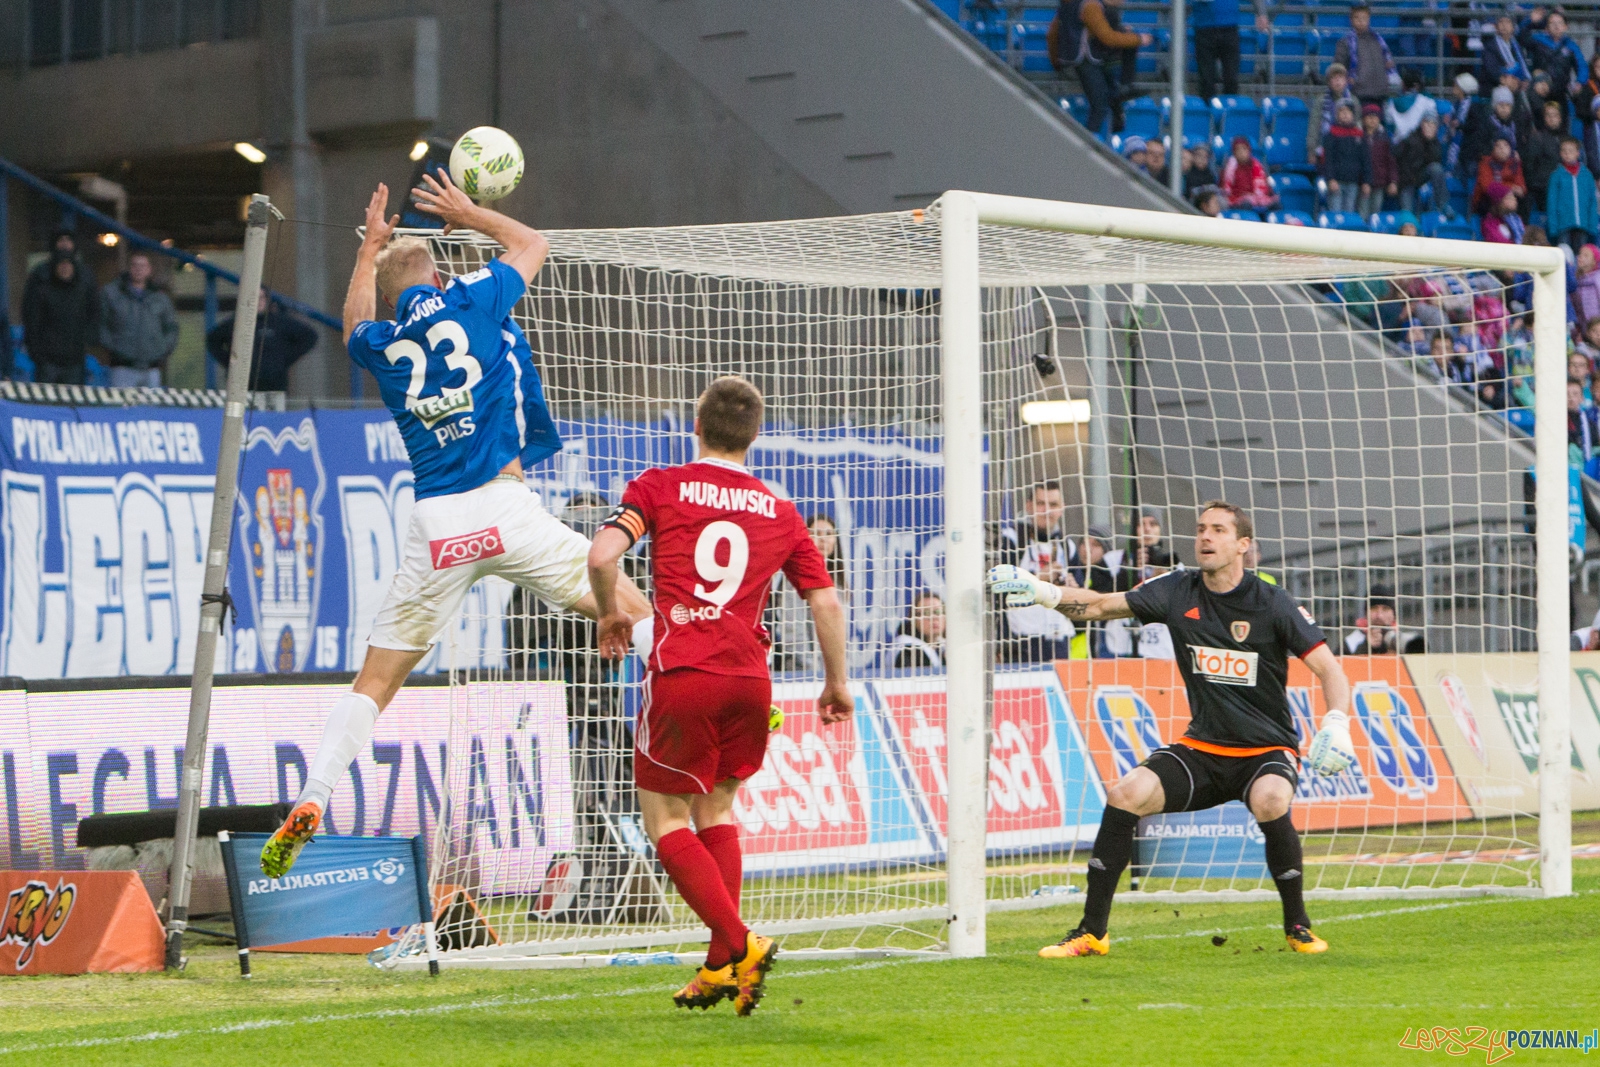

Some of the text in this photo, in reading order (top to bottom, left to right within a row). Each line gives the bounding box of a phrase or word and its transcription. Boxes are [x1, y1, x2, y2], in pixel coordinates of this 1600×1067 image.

[384, 320, 483, 410] 23
[12, 416, 204, 464] PYRLANDIA FOREVER
[434, 416, 476, 448] PILS
[679, 481, 777, 519] MURAWSKI
[433, 531, 503, 568] Fogo
[693, 520, 749, 607] 9
[235, 627, 257, 670] 20
[315, 626, 339, 669] 15
[2, 703, 545, 872] LECHA POZNAŃ
